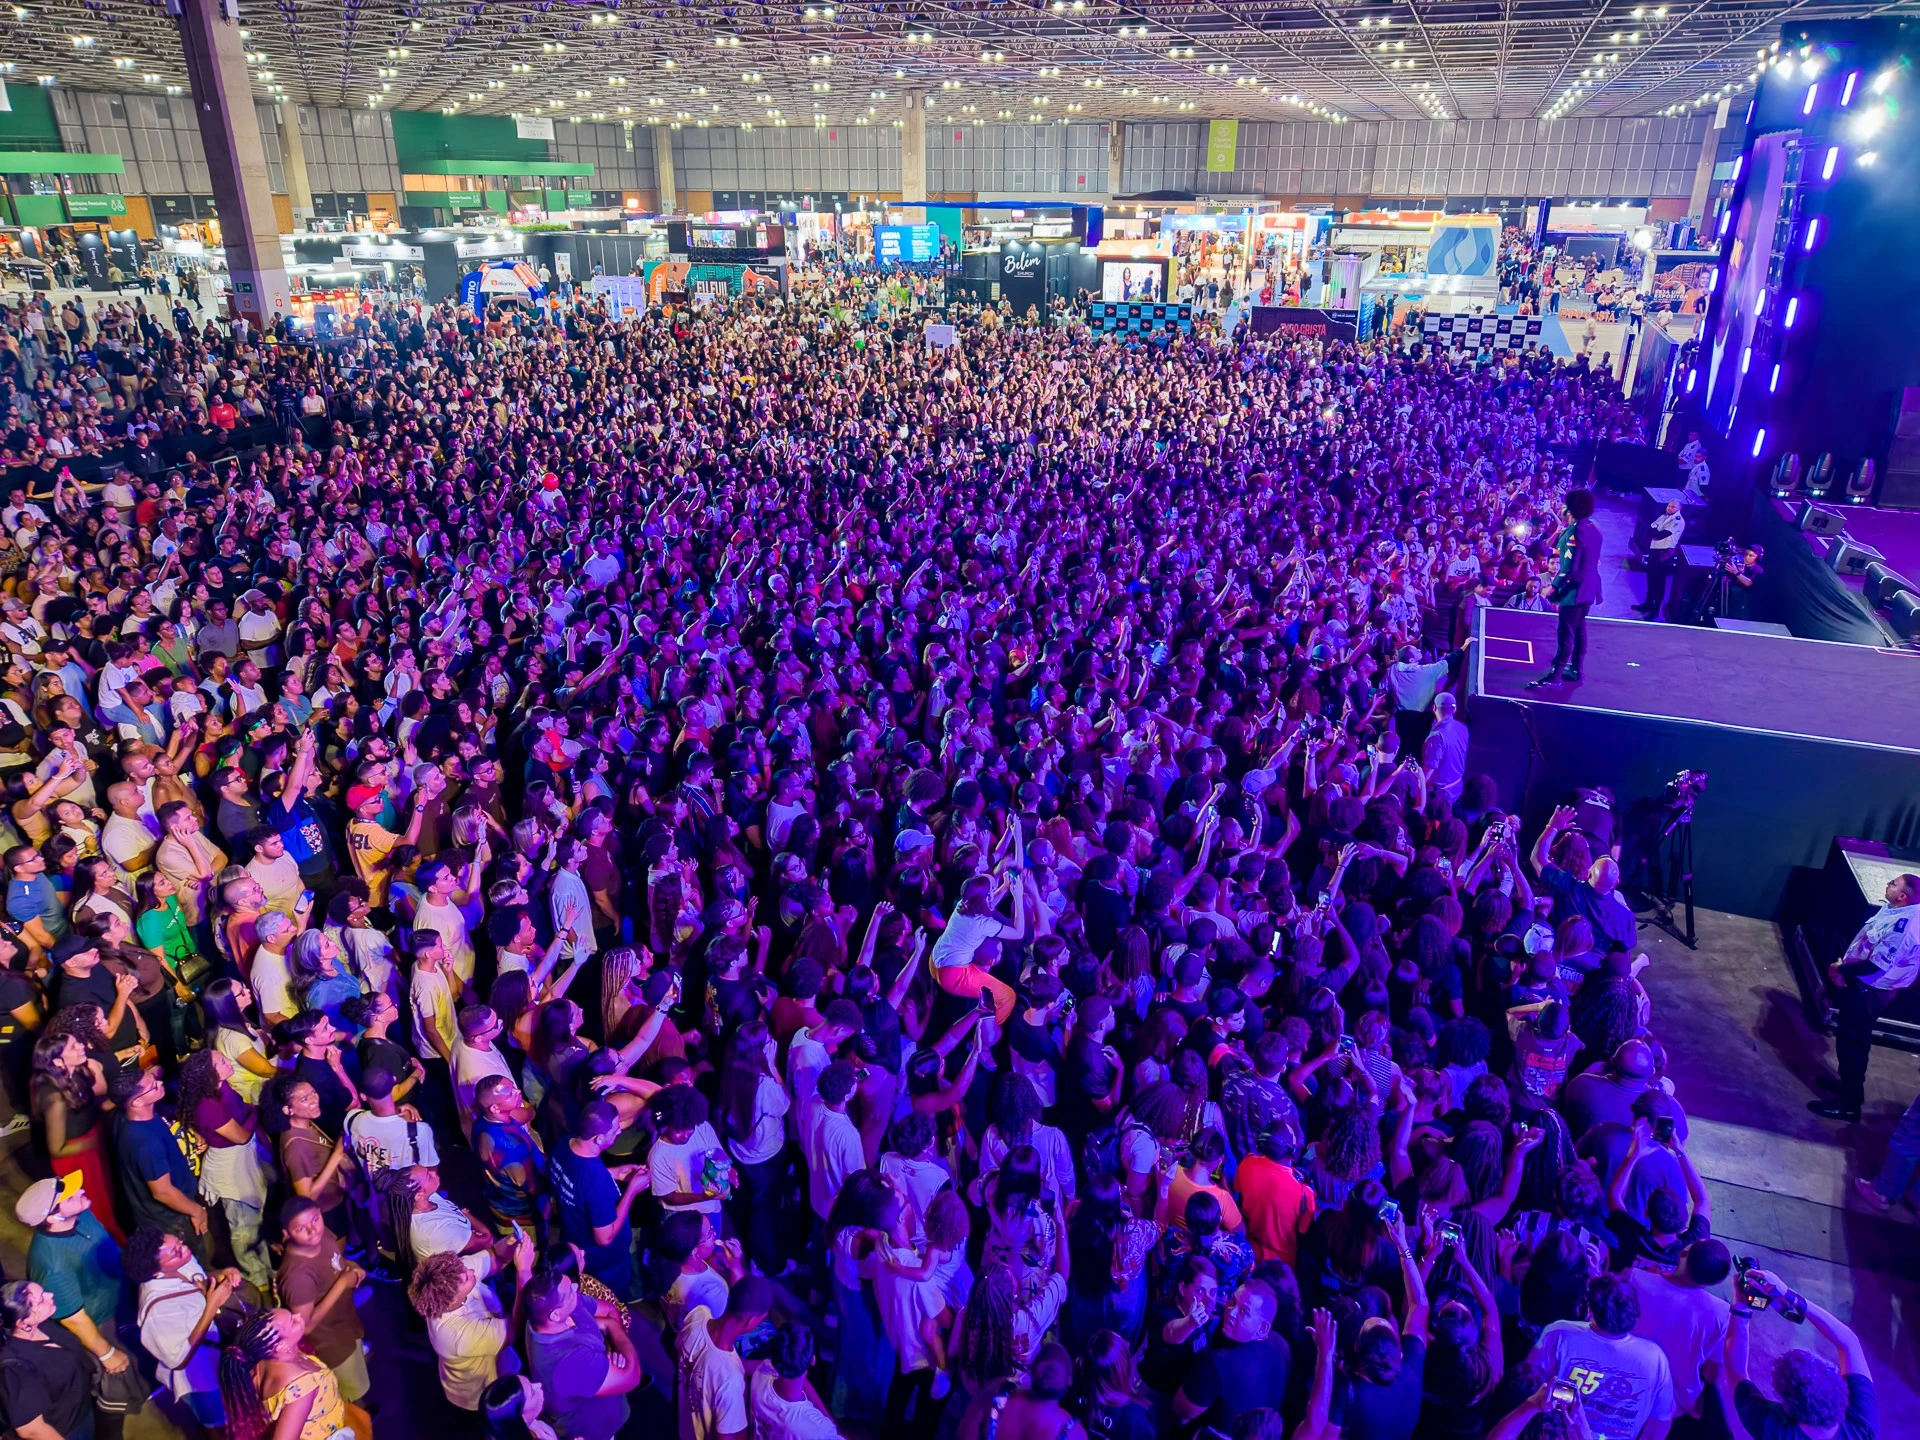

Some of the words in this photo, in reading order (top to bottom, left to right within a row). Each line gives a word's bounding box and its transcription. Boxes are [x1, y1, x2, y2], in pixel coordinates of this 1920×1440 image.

[1004, 251, 1041, 273] Belém
[463, 280, 477, 312] alamo
[1568, 1366, 1604, 1395] 55
